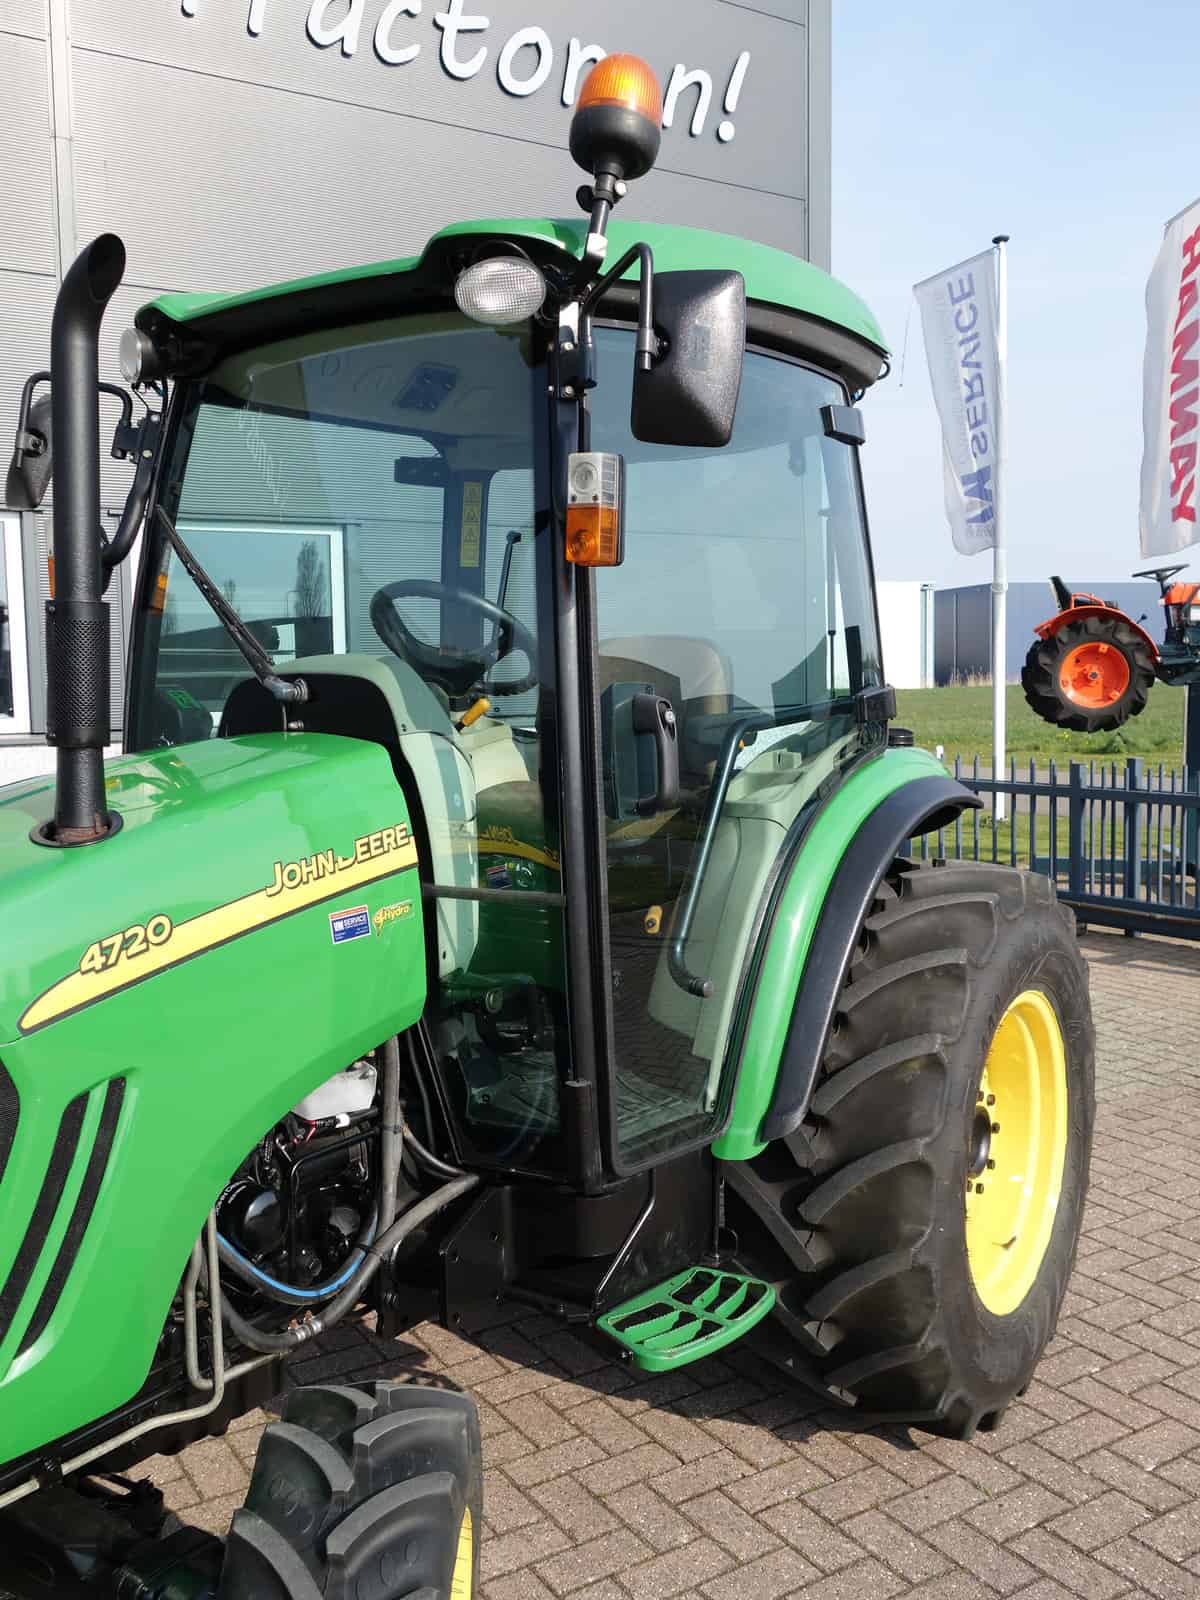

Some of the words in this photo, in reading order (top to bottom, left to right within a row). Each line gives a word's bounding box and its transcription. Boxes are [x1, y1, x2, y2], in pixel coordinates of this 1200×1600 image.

[180, 0, 750, 143] actorn!
[265, 848, 335, 897] JOHN
[79, 913, 173, 975] 4720
